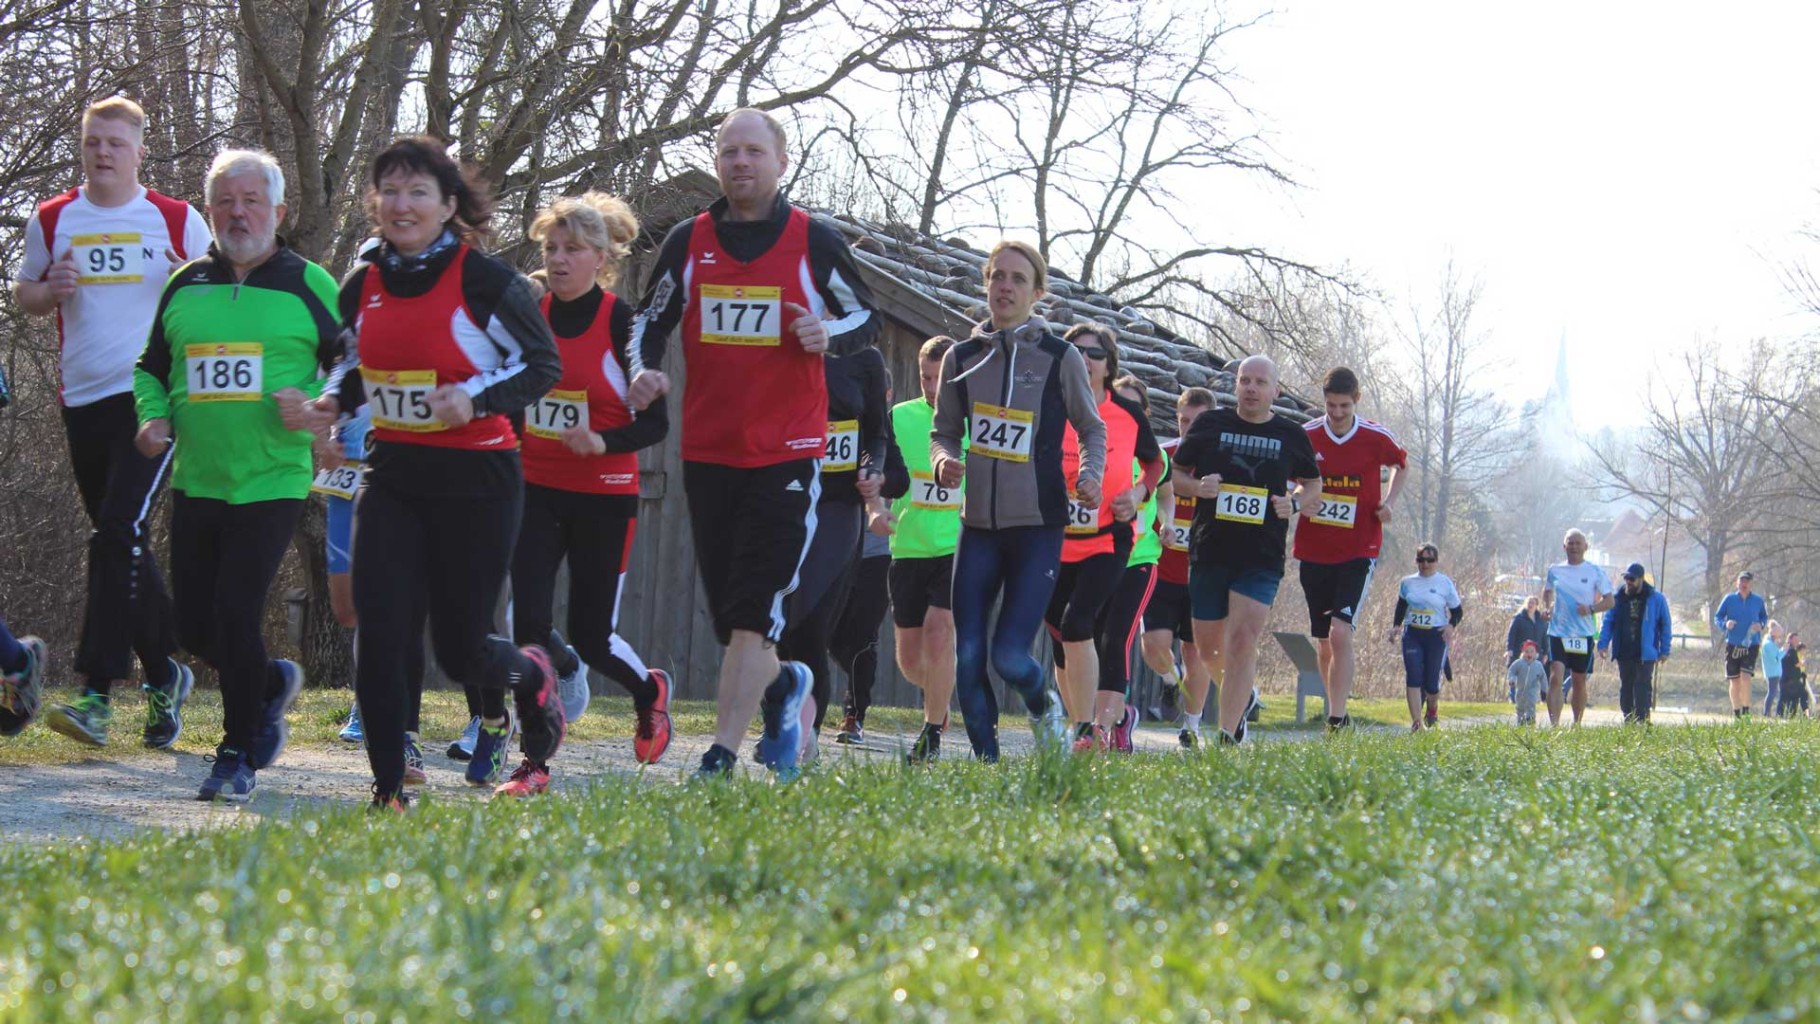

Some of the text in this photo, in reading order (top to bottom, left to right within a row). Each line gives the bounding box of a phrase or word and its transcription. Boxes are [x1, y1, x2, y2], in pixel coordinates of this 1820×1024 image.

[89, 248, 124, 272] 95
[711, 303, 770, 332] 177
[195, 360, 251, 389] 186
[373, 386, 432, 420] 175
[531, 401, 579, 430] 179
[976, 418, 1026, 450] 247
[1218, 432, 1281, 460] PUMA
[826, 436, 851, 460] 46
[323, 470, 356, 489] 133
[923, 482, 949, 503] 76
[1225, 496, 1259, 516] 168
[1317, 501, 1350, 520] 242
[1411, 613, 1432, 625] 212
[1568, 640, 1581, 650] 18
